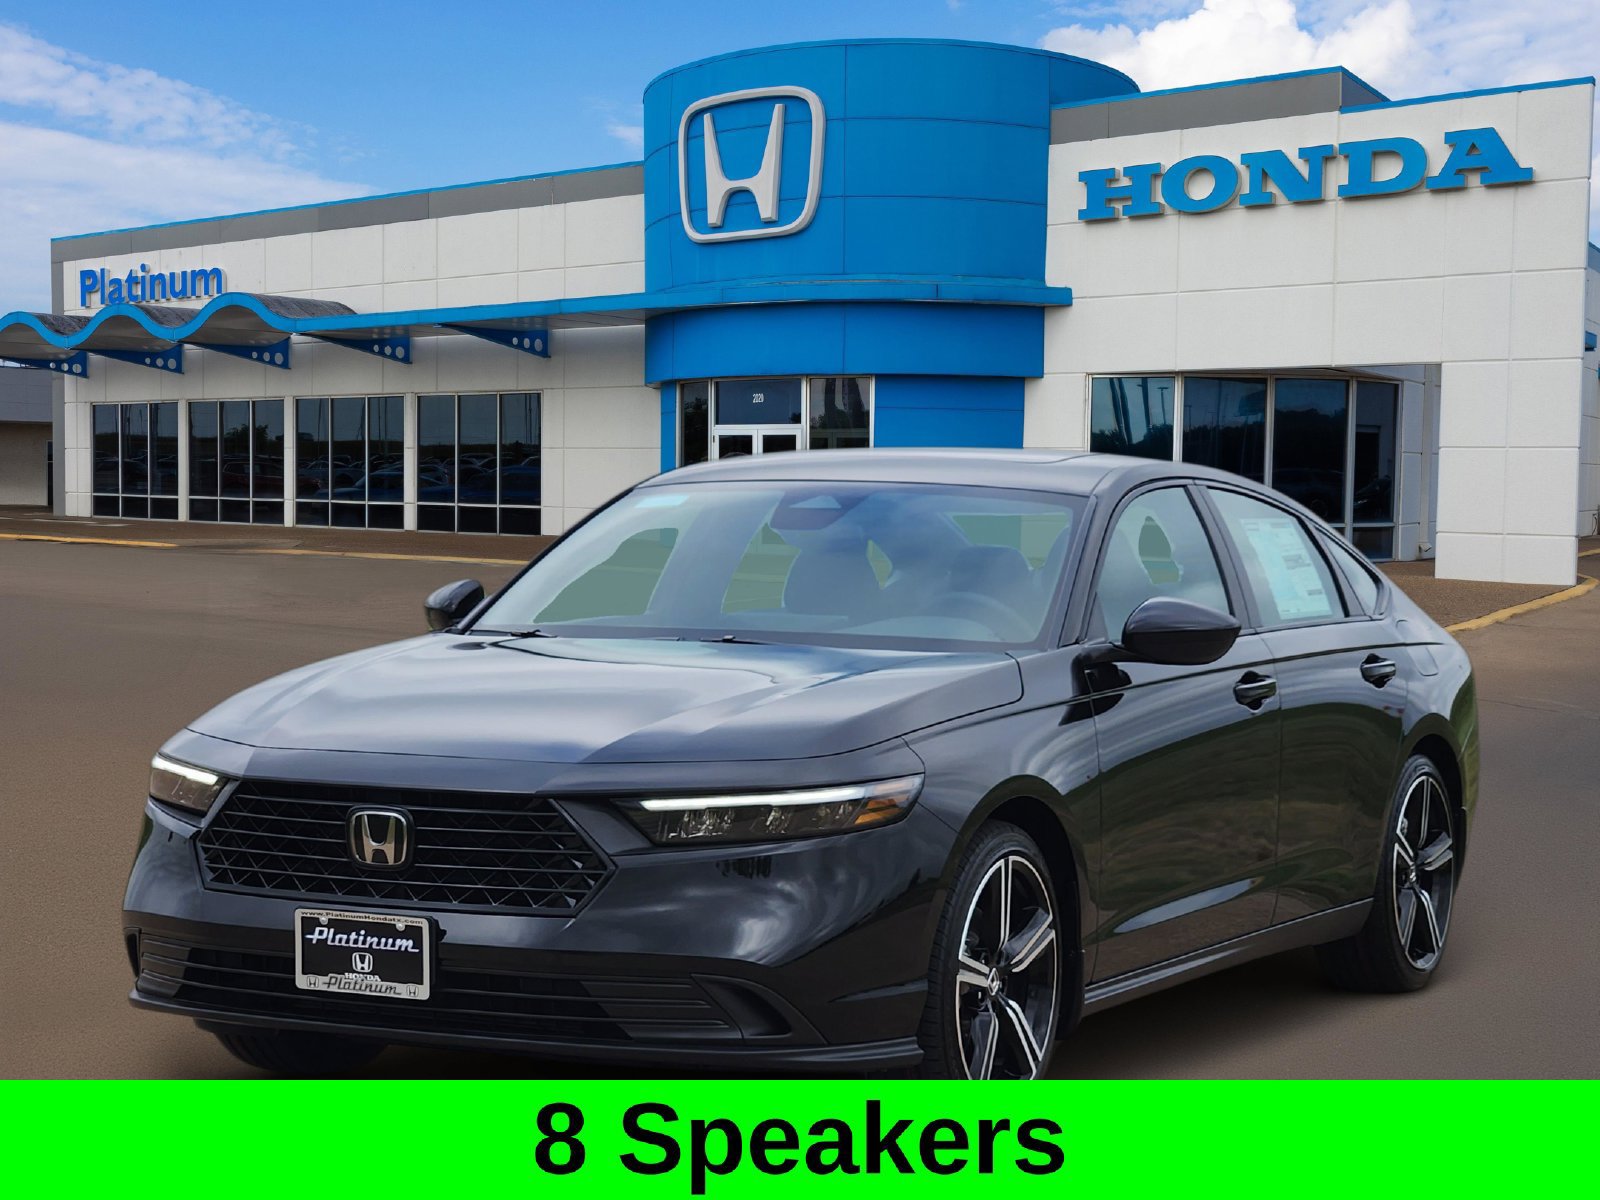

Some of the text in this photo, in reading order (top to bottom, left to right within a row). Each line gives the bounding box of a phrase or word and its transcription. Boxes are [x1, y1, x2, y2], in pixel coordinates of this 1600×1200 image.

[1078, 127, 1534, 222] HONDA
[79, 263, 224, 307] Platinum
[305, 927, 419, 952] Platinum
[322, 975, 402, 995] Platinum
